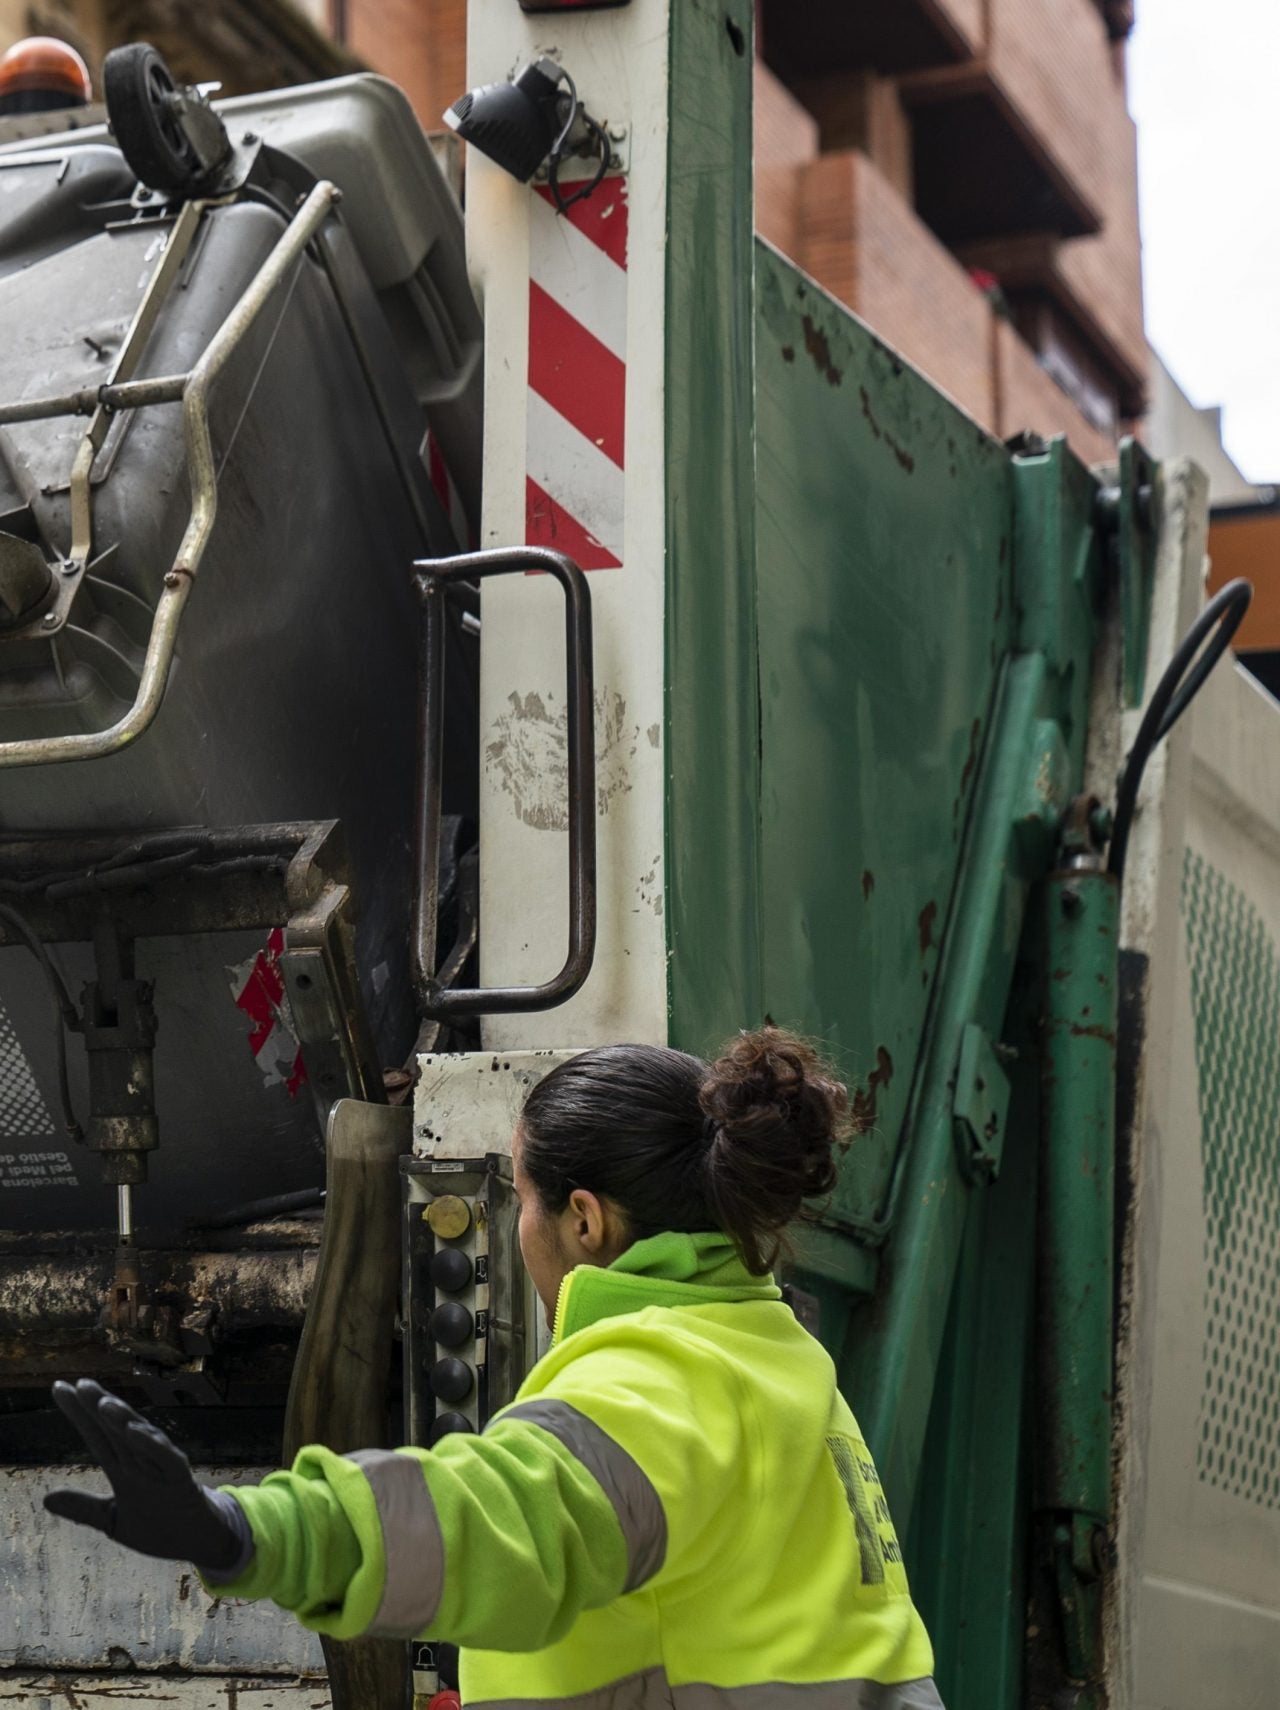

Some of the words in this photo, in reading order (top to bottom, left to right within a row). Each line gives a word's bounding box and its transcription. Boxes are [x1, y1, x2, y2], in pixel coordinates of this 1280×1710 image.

[19, 1152, 68, 1164] Gestió
[8, 1165, 46, 1177] Medi
[49, 1162, 72, 1174] pel
[1, 1176, 79, 1187] Barcelona
